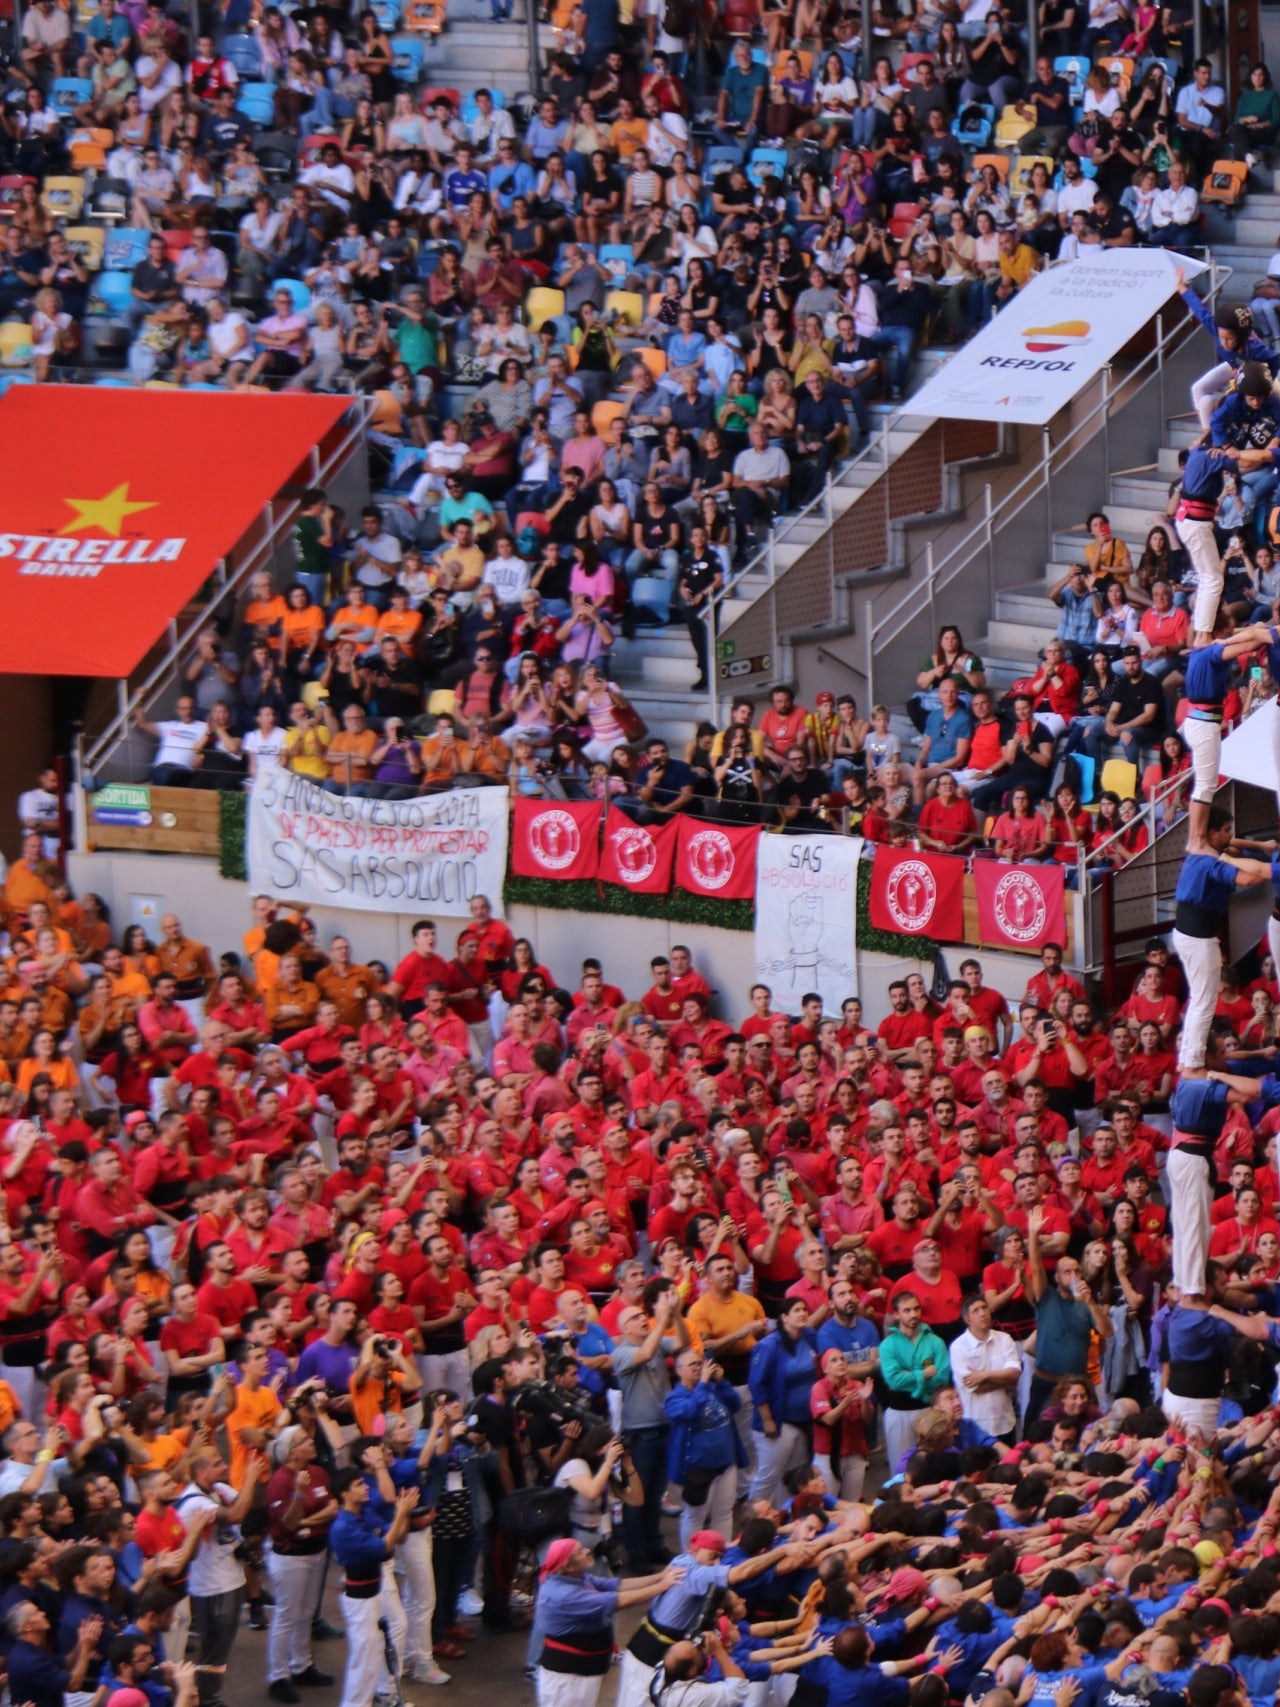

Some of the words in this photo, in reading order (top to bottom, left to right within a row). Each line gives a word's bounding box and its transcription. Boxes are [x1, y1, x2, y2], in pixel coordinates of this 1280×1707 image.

[980, 356, 1076, 372] REPSOL
[18, 561, 105, 578] DAMM
[371, 825, 399, 854] PER
[271, 841, 346, 893] SAS
[351, 855, 478, 903] ABSOLUCIÓ
[789, 844, 824, 872] SAS
[890, 863, 927, 882] XICOTS
[997, 873, 1033, 897] XICOTS
[889, 891, 935, 929] VILAFRANCA
[997, 903, 1044, 939] VILAFRANCA
